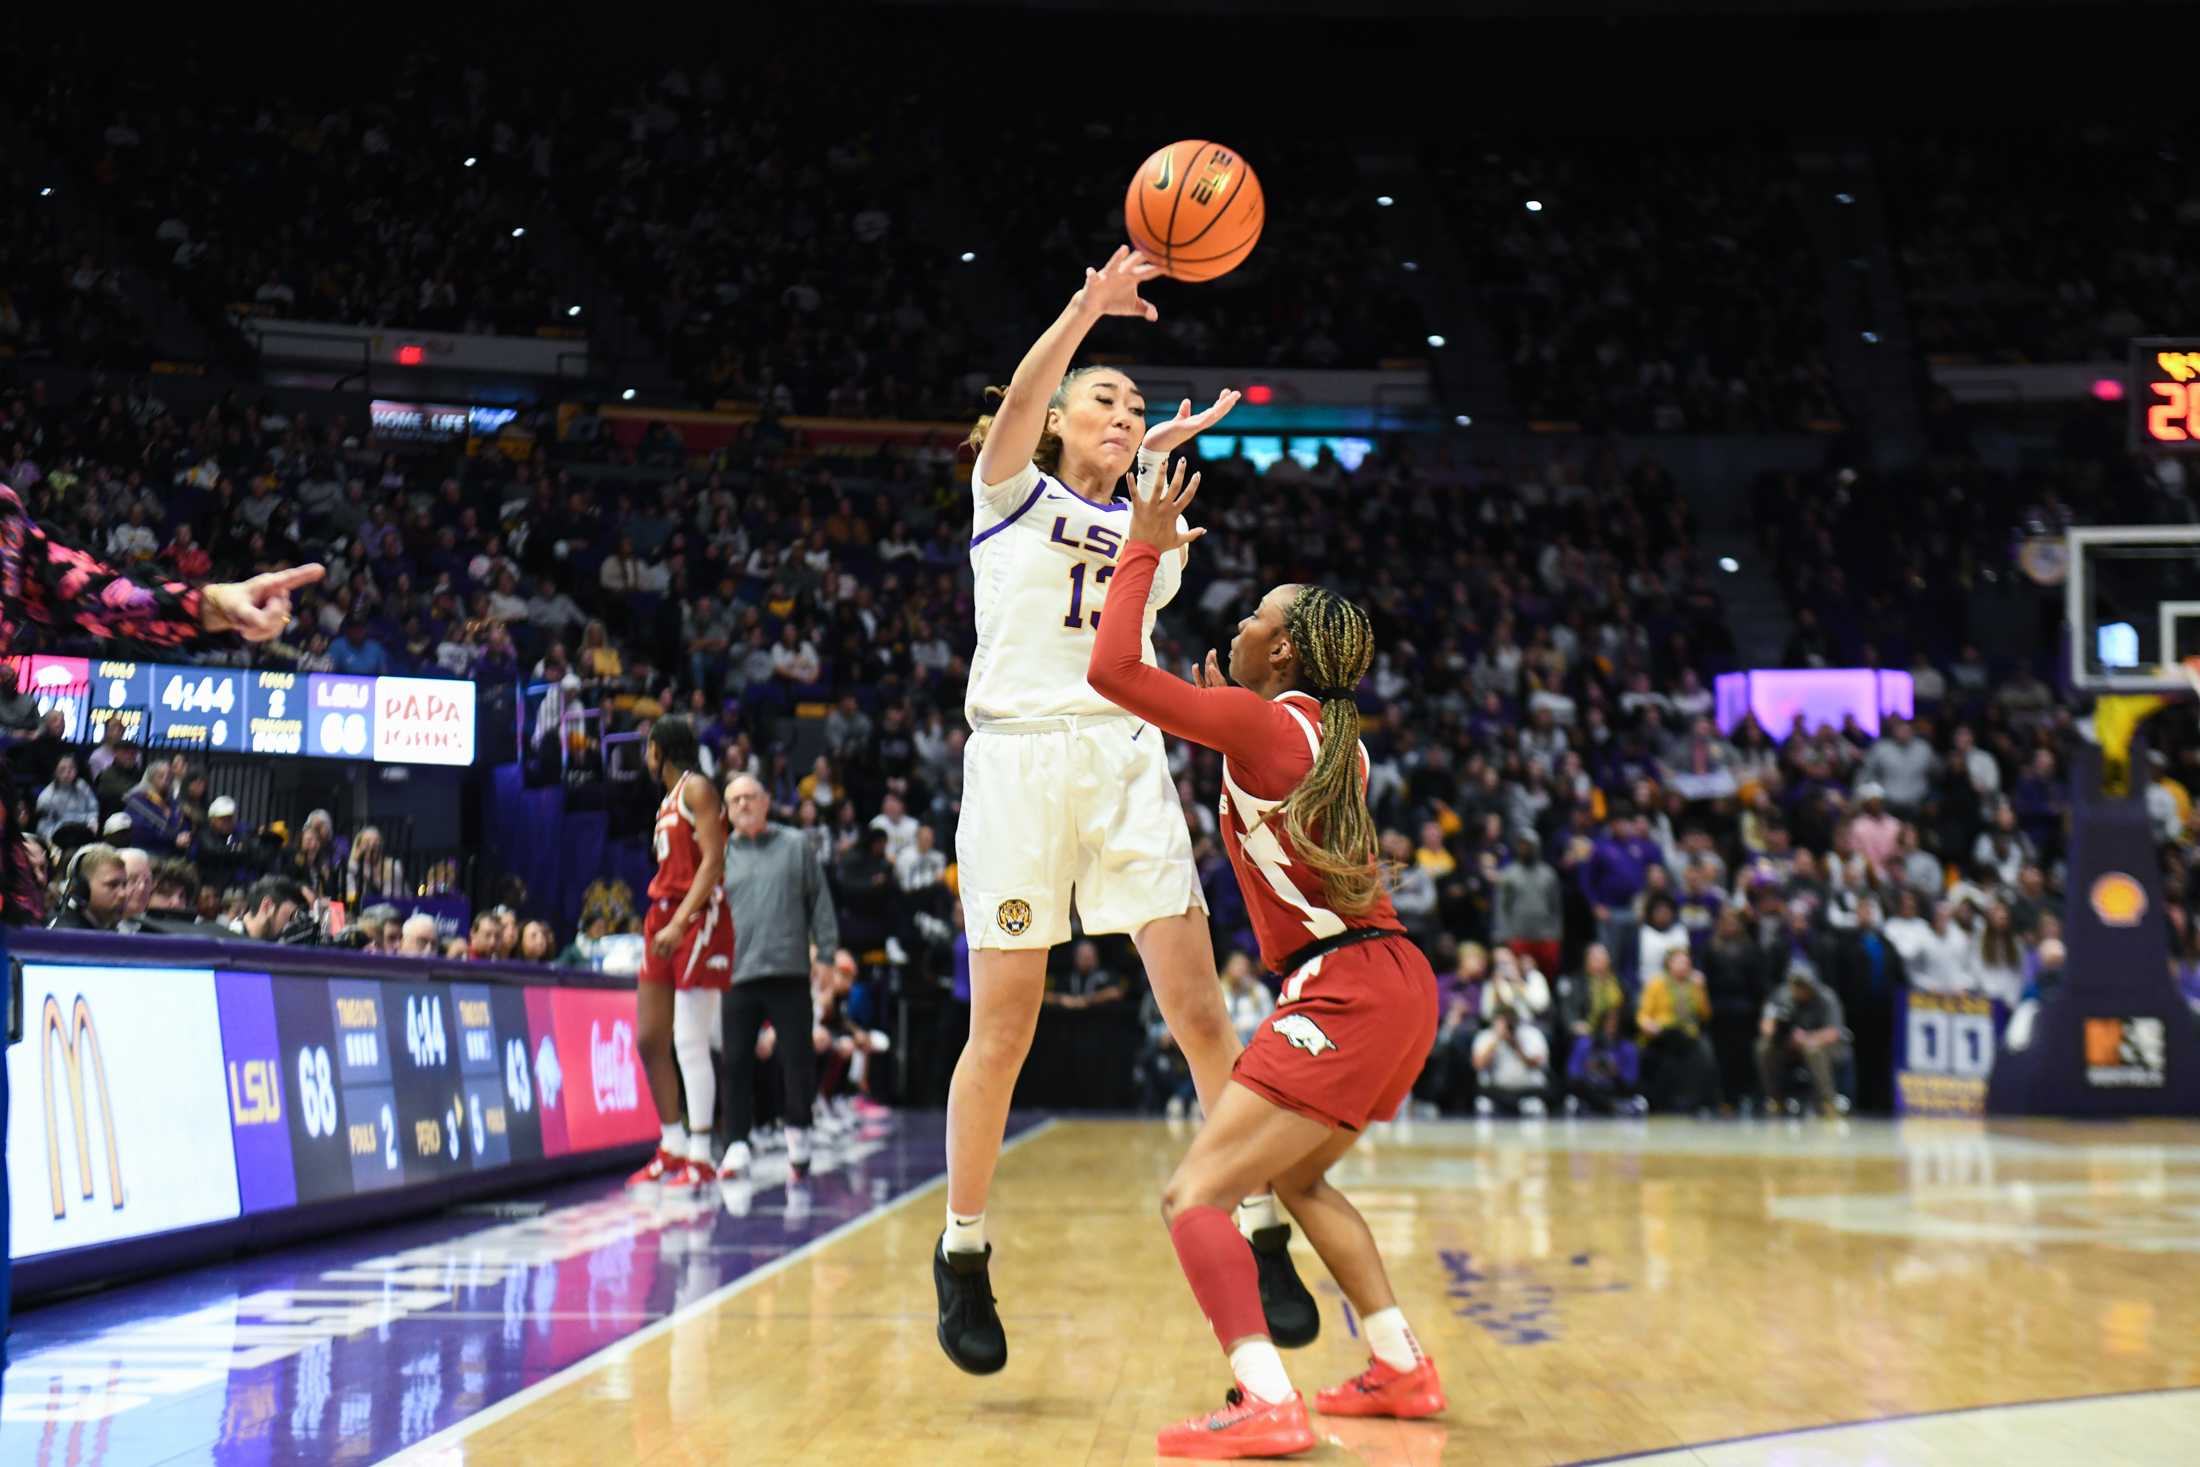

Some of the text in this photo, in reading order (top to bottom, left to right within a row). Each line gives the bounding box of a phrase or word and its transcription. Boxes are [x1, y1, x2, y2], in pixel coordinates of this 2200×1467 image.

[1051, 516, 1129, 561] LS
[162, 674, 234, 714] 4:44
[386, 694, 460, 722] PAPA
[407, 995, 446, 1067] 4:44
[229, 1059, 281, 1126] LSU
[298, 1046, 337, 1138] 68
[381, 1103, 398, 1171] 2
